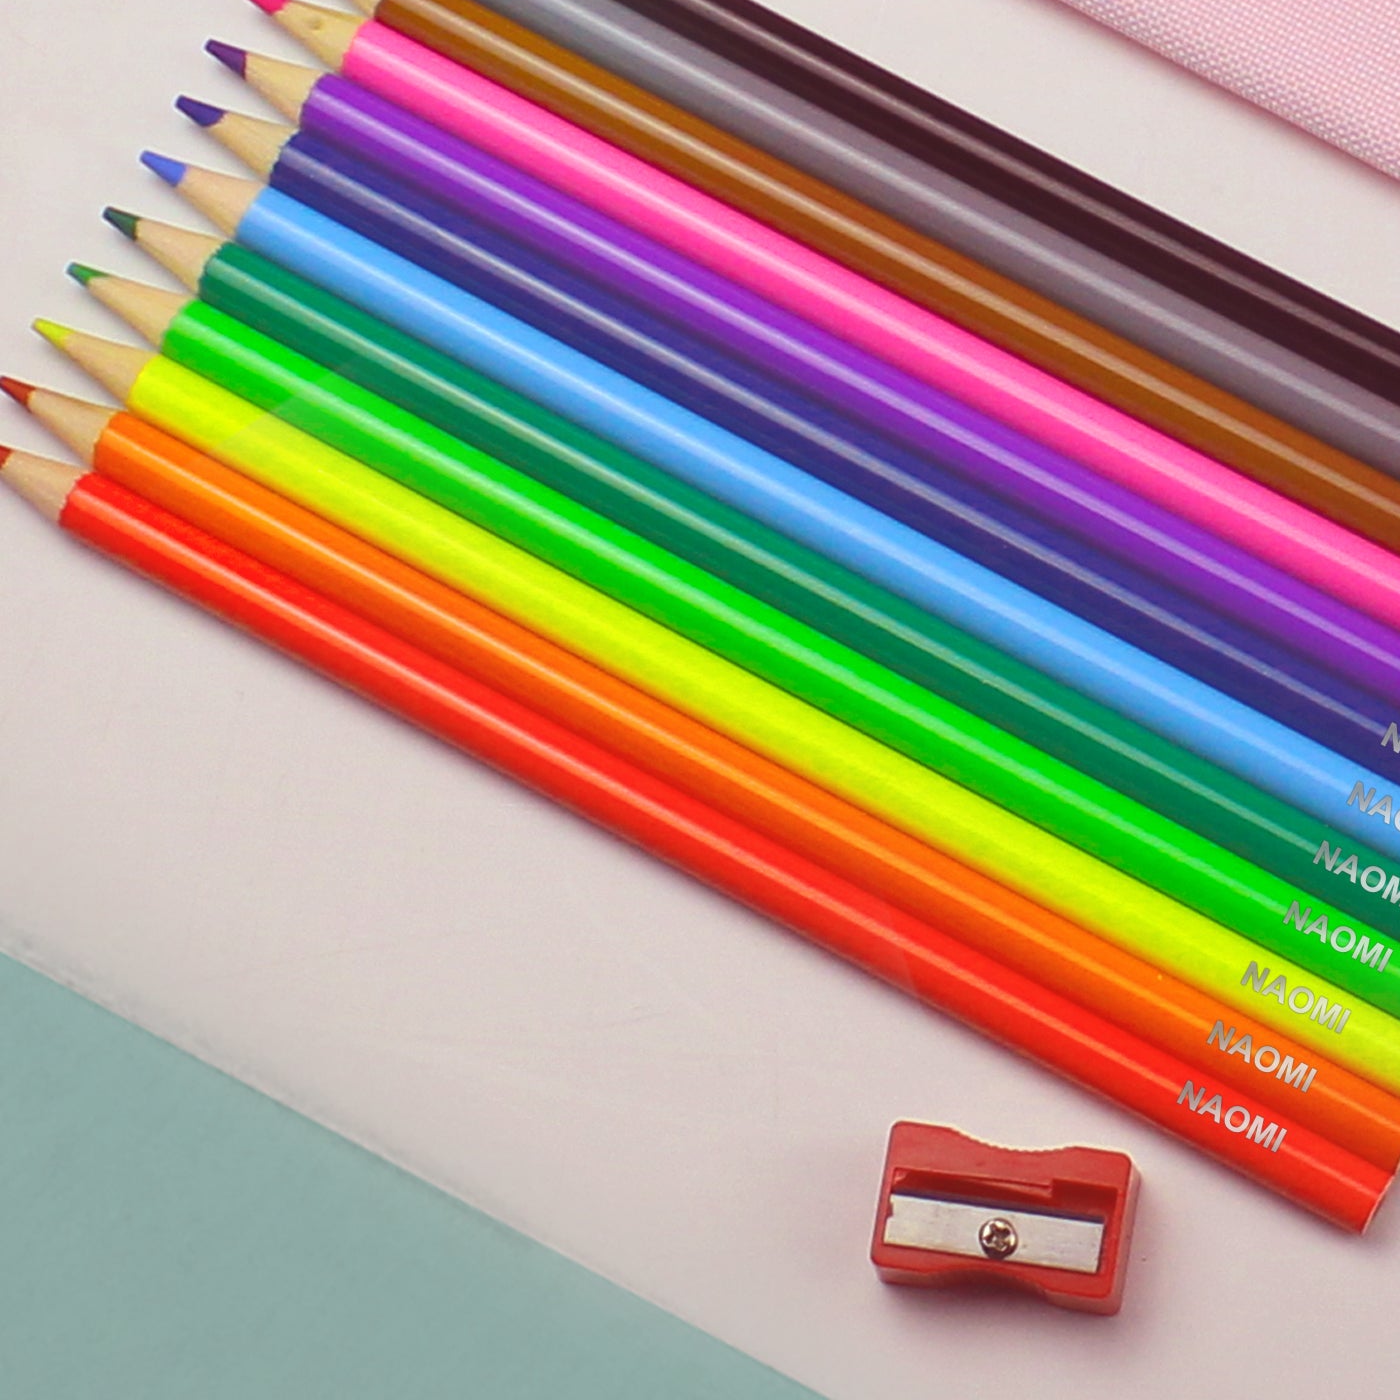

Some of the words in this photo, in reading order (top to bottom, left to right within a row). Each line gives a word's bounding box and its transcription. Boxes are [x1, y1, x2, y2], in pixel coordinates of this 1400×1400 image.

[1282, 900, 1394, 973] NAOMI
[1241, 961, 1351, 1034] NAOMI
[1207, 1020, 1317, 1093] NAOMI
[1176, 1080, 1287, 1153] NAOMI
